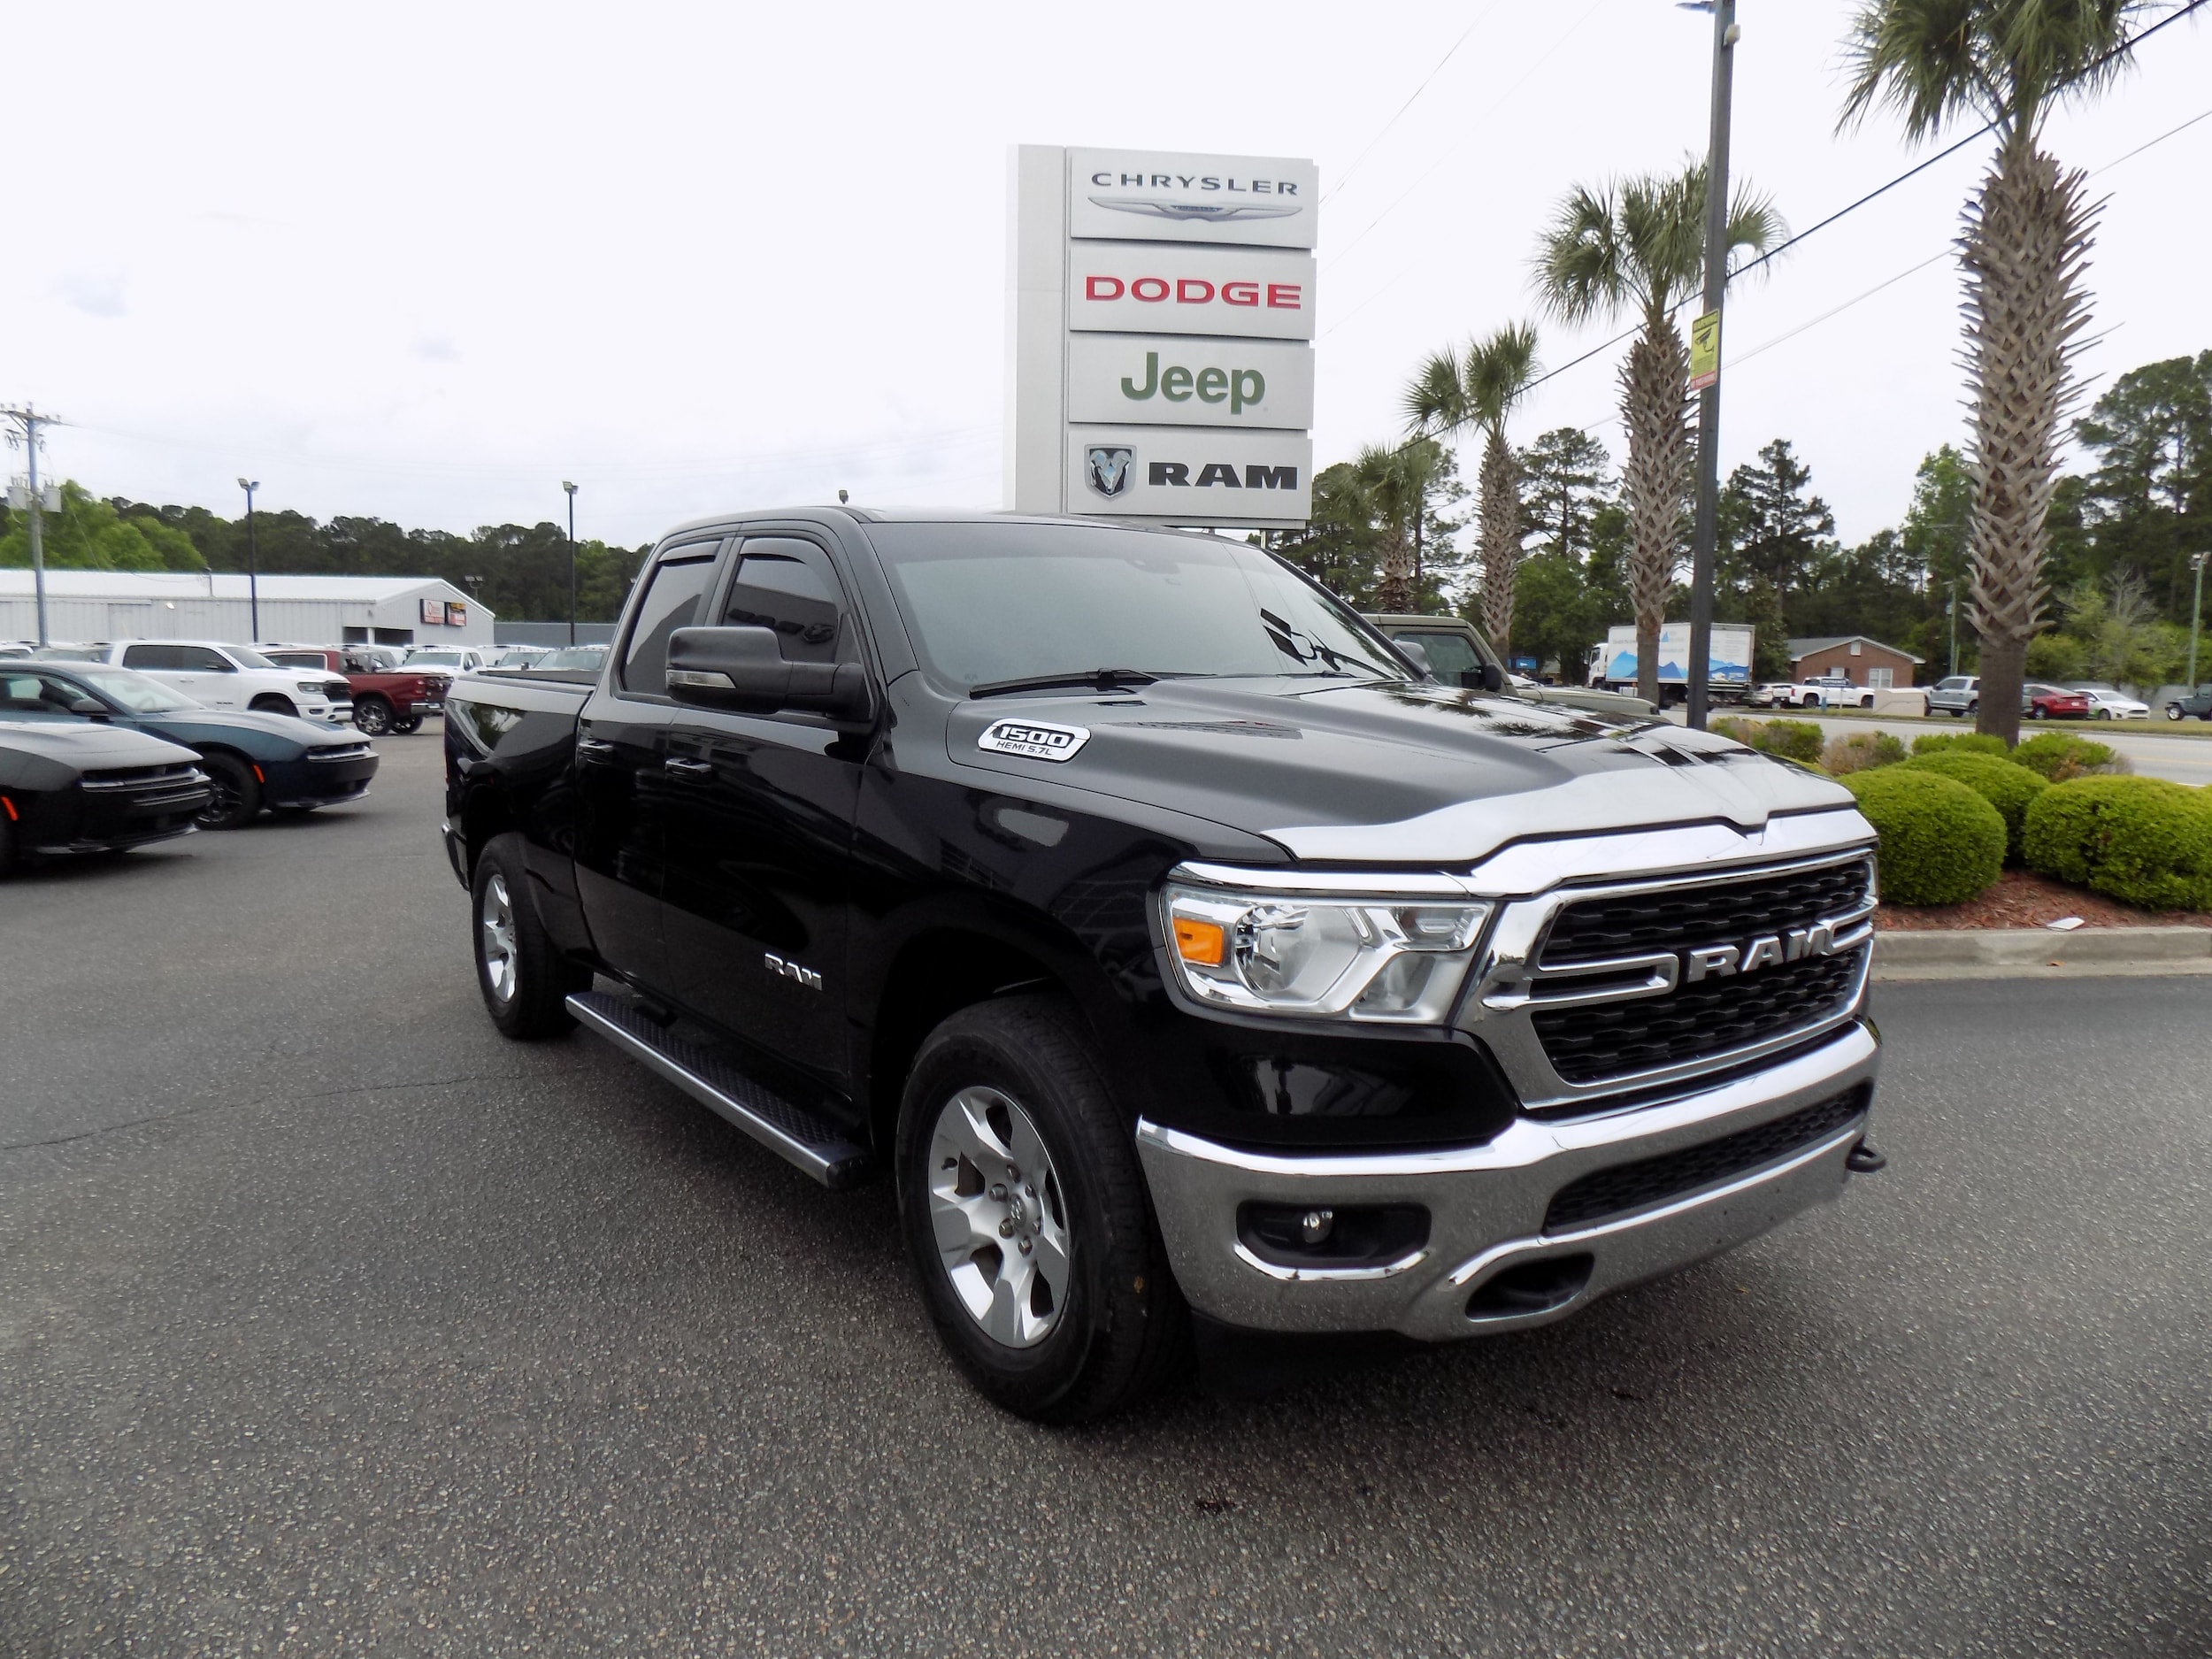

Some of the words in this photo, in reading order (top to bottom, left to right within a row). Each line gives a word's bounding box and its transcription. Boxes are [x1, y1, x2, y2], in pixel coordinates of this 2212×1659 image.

[1091, 173, 1298, 196] CHRYSLER
[1086, 276, 1302, 309] DODGE
[1121, 351, 1265, 415] Jeep
[1149, 462, 1298, 490] RAM
[996, 741, 1025, 751] HEMI
[1027, 746, 1053, 756] 5.7L
[999, 726, 1071, 748] 1500
[1687, 924, 1829, 983] RAM
[764, 953, 822, 991] RAM
